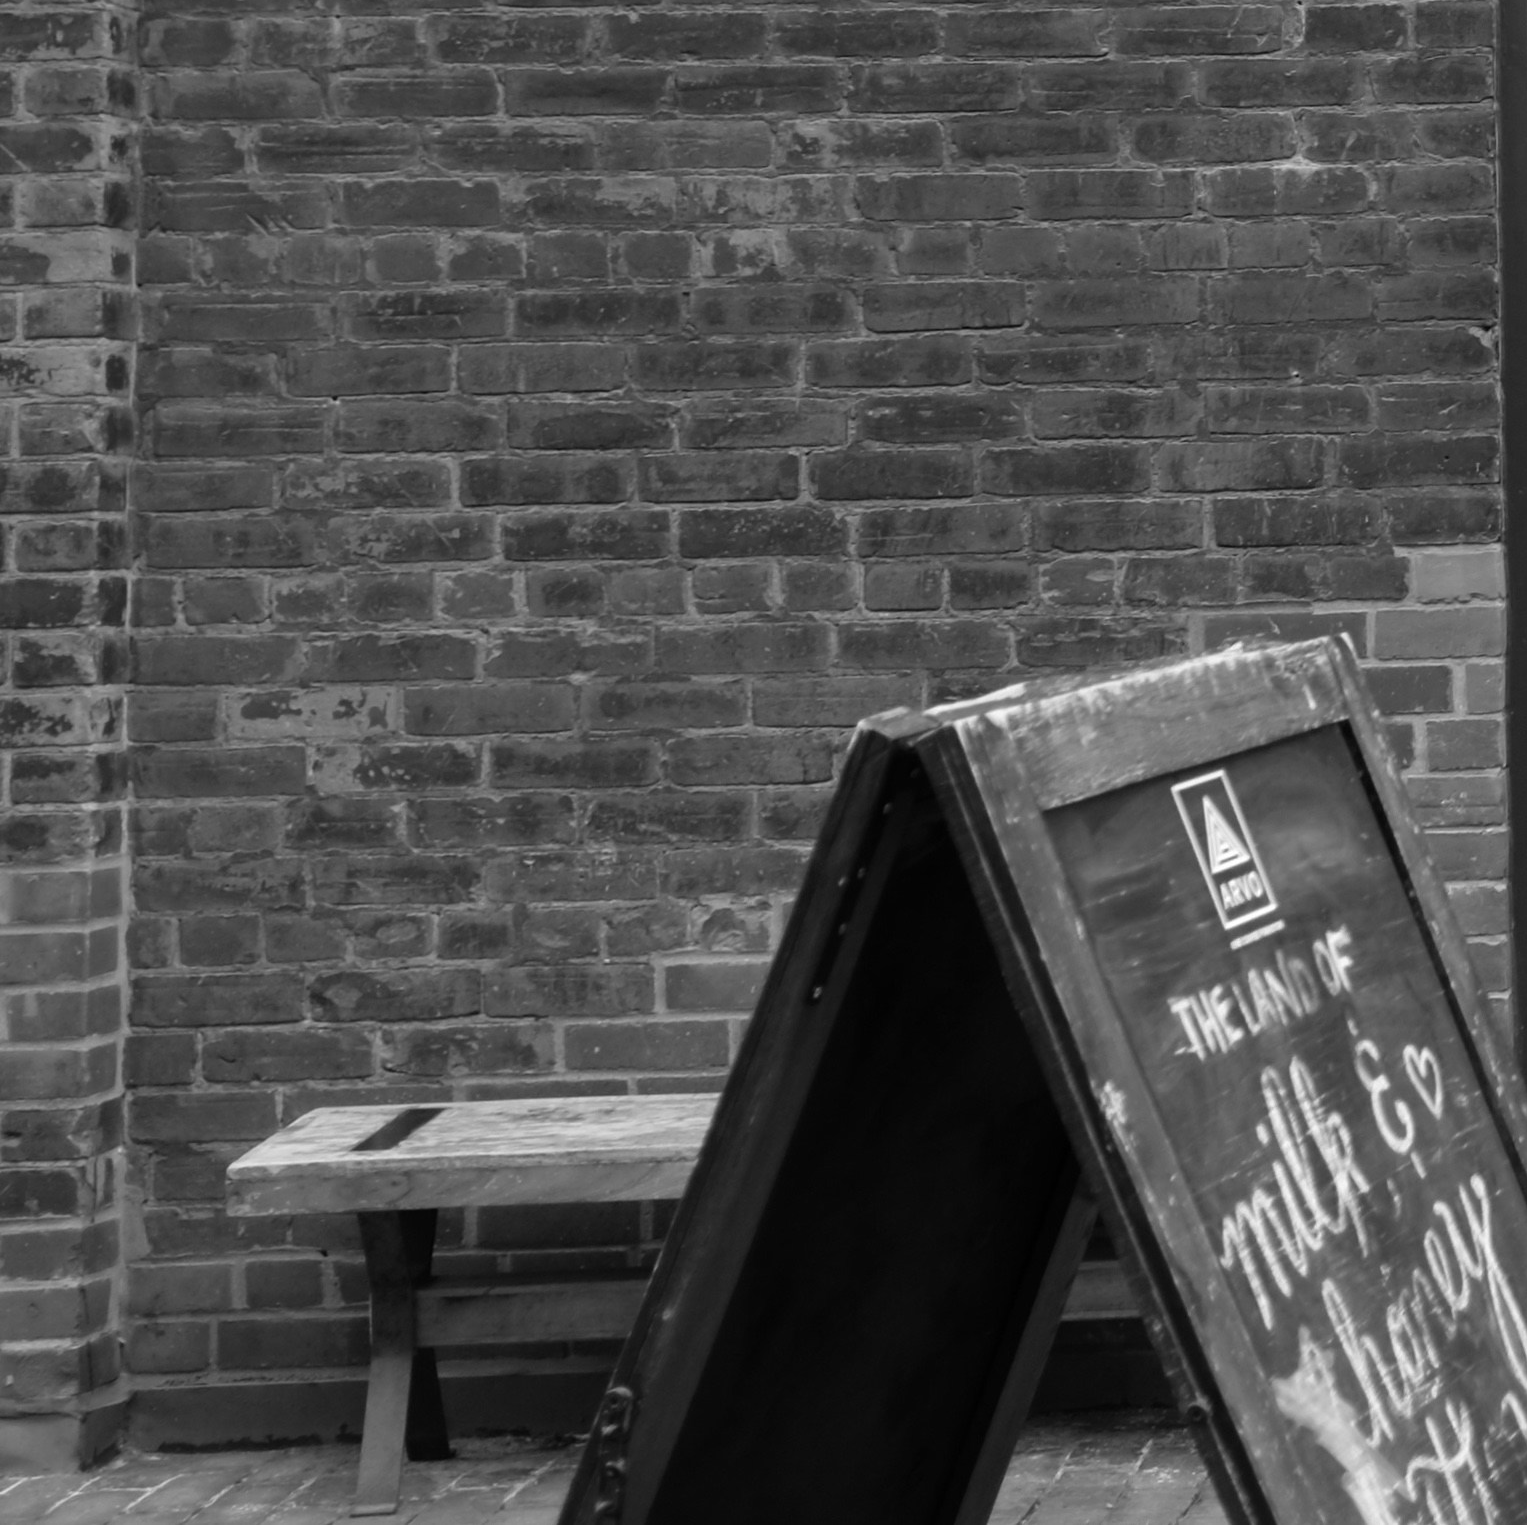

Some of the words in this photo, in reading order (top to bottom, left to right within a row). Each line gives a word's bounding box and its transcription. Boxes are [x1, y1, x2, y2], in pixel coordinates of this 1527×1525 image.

[1219, 870, 1264, 911] ARVO
[1167, 983, 1245, 1061] THE
[1231, 948, 1320, 1036] LAND
[1312, 924, 1353, 997] OF
[1219, 1055, 1371, 1331] milk
